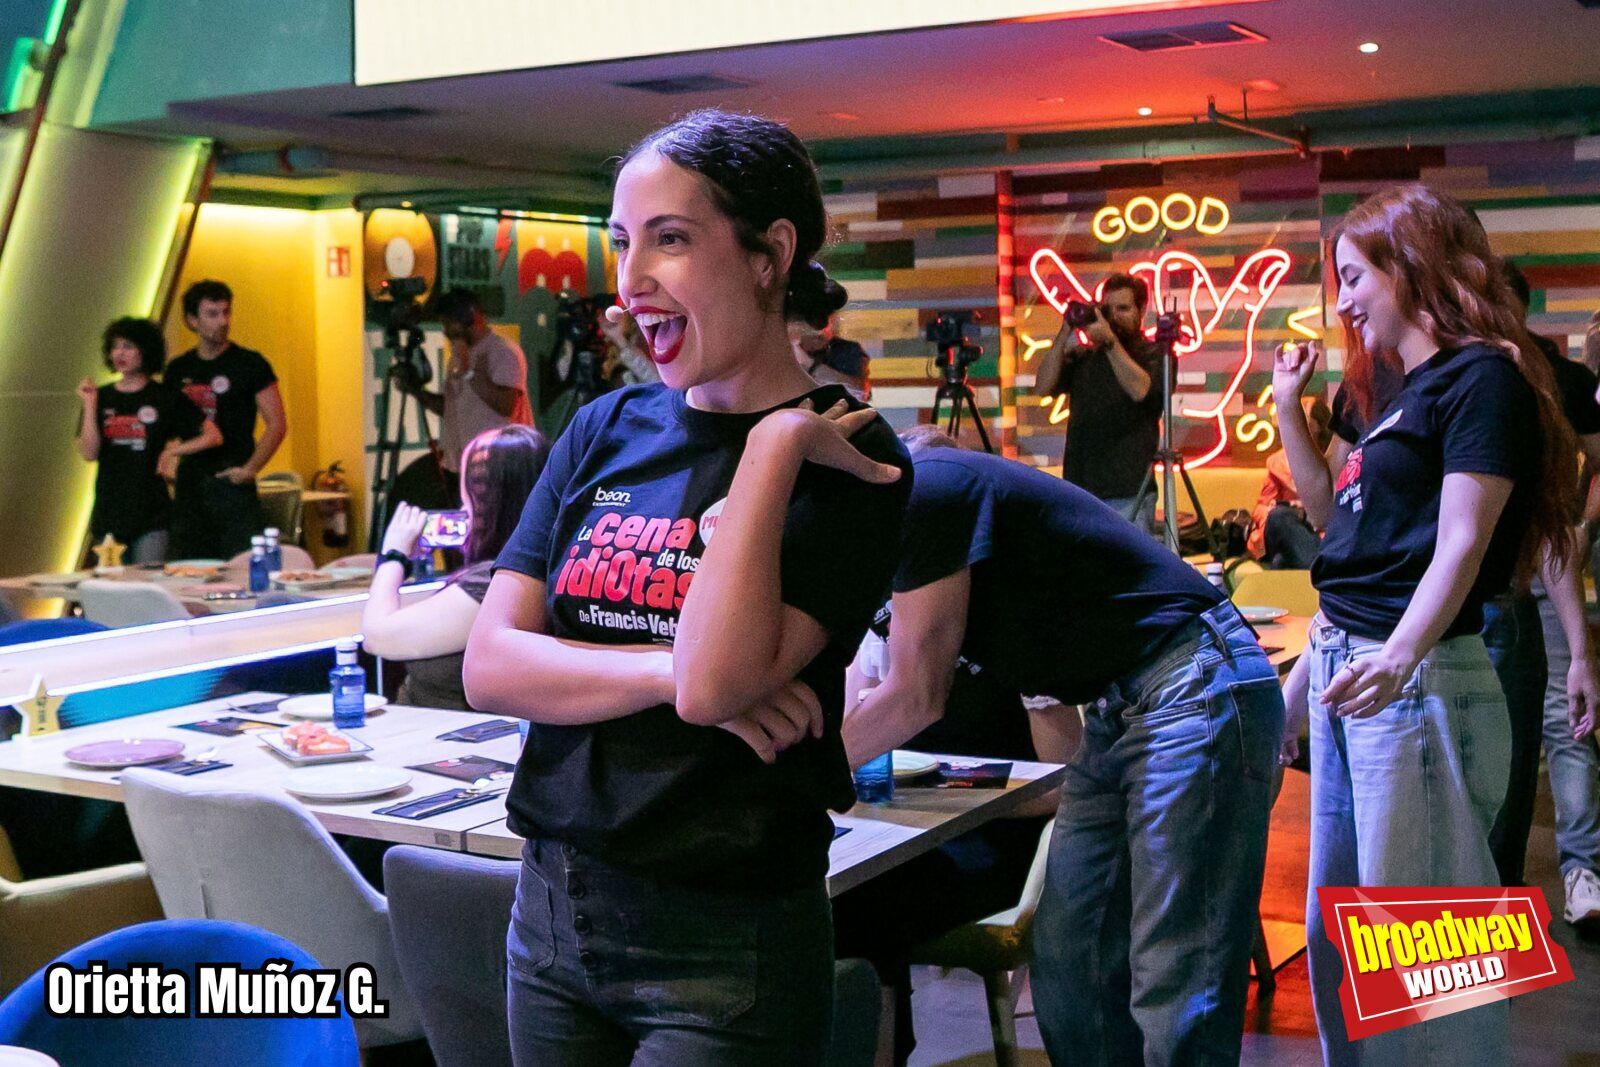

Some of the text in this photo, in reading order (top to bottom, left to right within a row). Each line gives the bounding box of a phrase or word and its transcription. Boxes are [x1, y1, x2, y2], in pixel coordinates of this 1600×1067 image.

[1092, 192, 1230, 243] GOOD
[578, 512, 697, 552] La cena
[656, 548, 700, 571] de los
[579, 609, 590, 623] De
[589, 604, 648, 630] Francis
